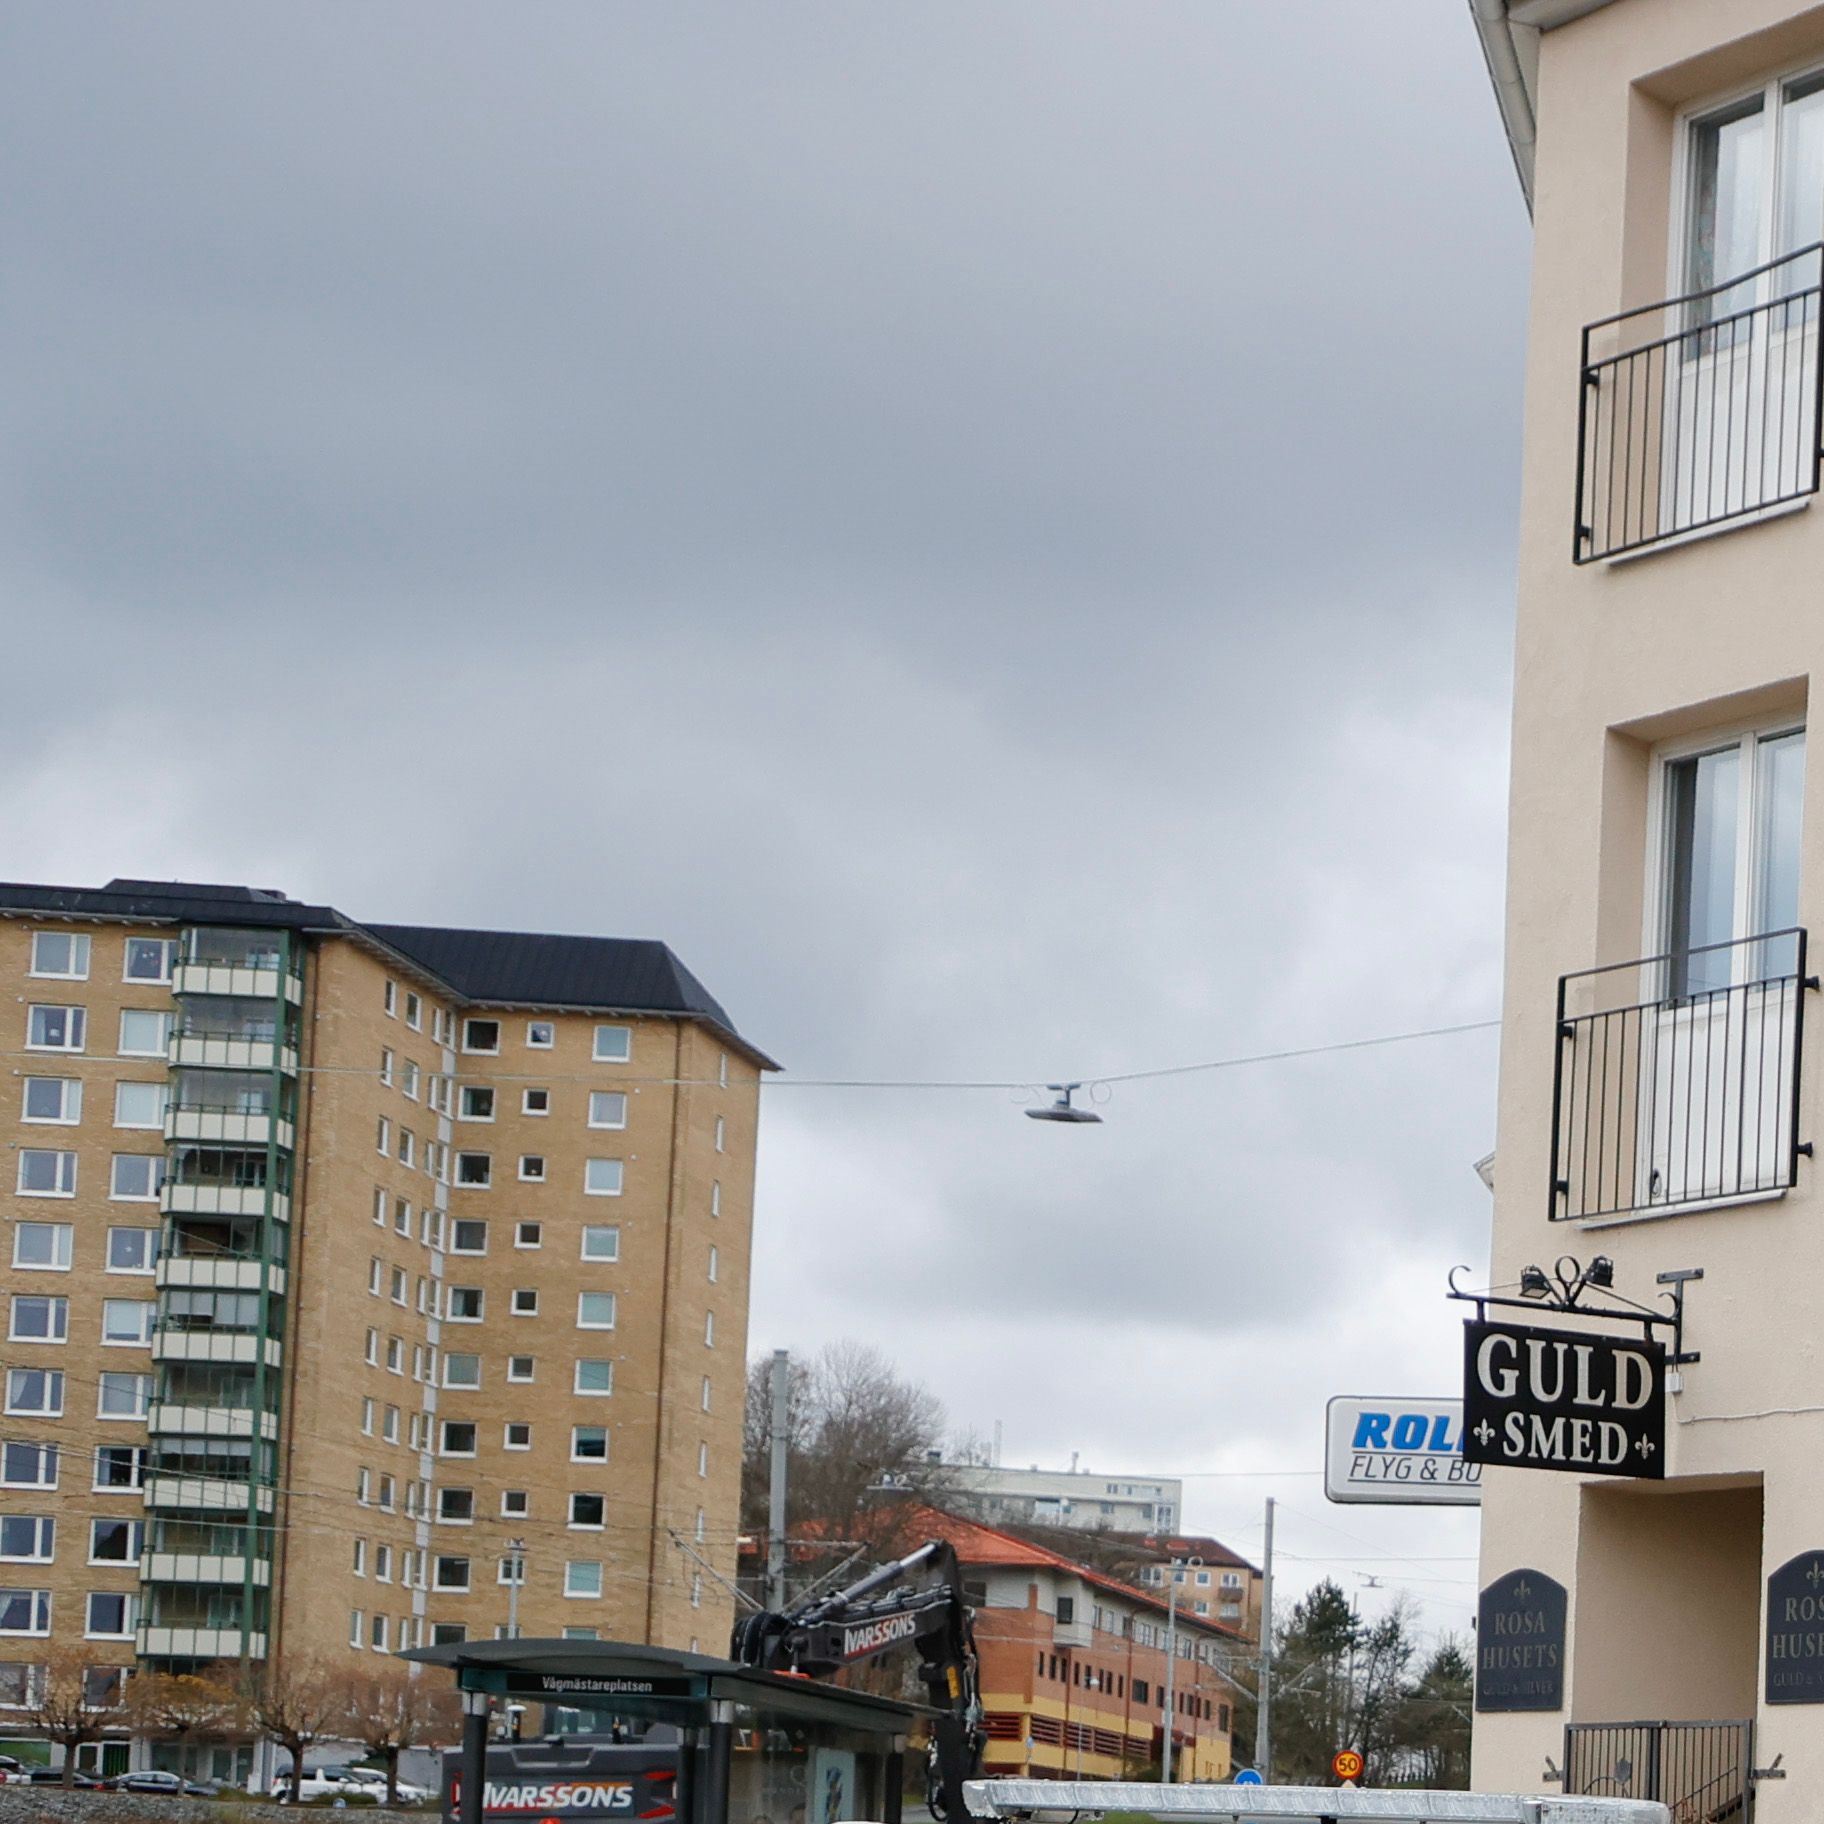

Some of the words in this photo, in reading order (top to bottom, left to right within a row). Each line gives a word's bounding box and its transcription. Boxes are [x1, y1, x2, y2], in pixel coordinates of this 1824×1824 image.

[1476, 1332, 1654, 1411] GULD
[1351, 1411, 1464, 1452] ROL
[1502, 1411, 1629, 1466] SMED
[1349, 1454, 1412, 1480] FLYG
[1420, 1457, 1438, 1481] &
[844, 1614, 917, 1654] IVARSSONS
[1494, 1610, 1546, 1635] ROSA
[1482, 1643, 1558, 1670] HUSETS
[542, 1676, 653, 1694] Vågmästareplatsen
[1339, 1757, 1358, 1772] 50
[482, 1781, 634, 1810] IVARSSONS
